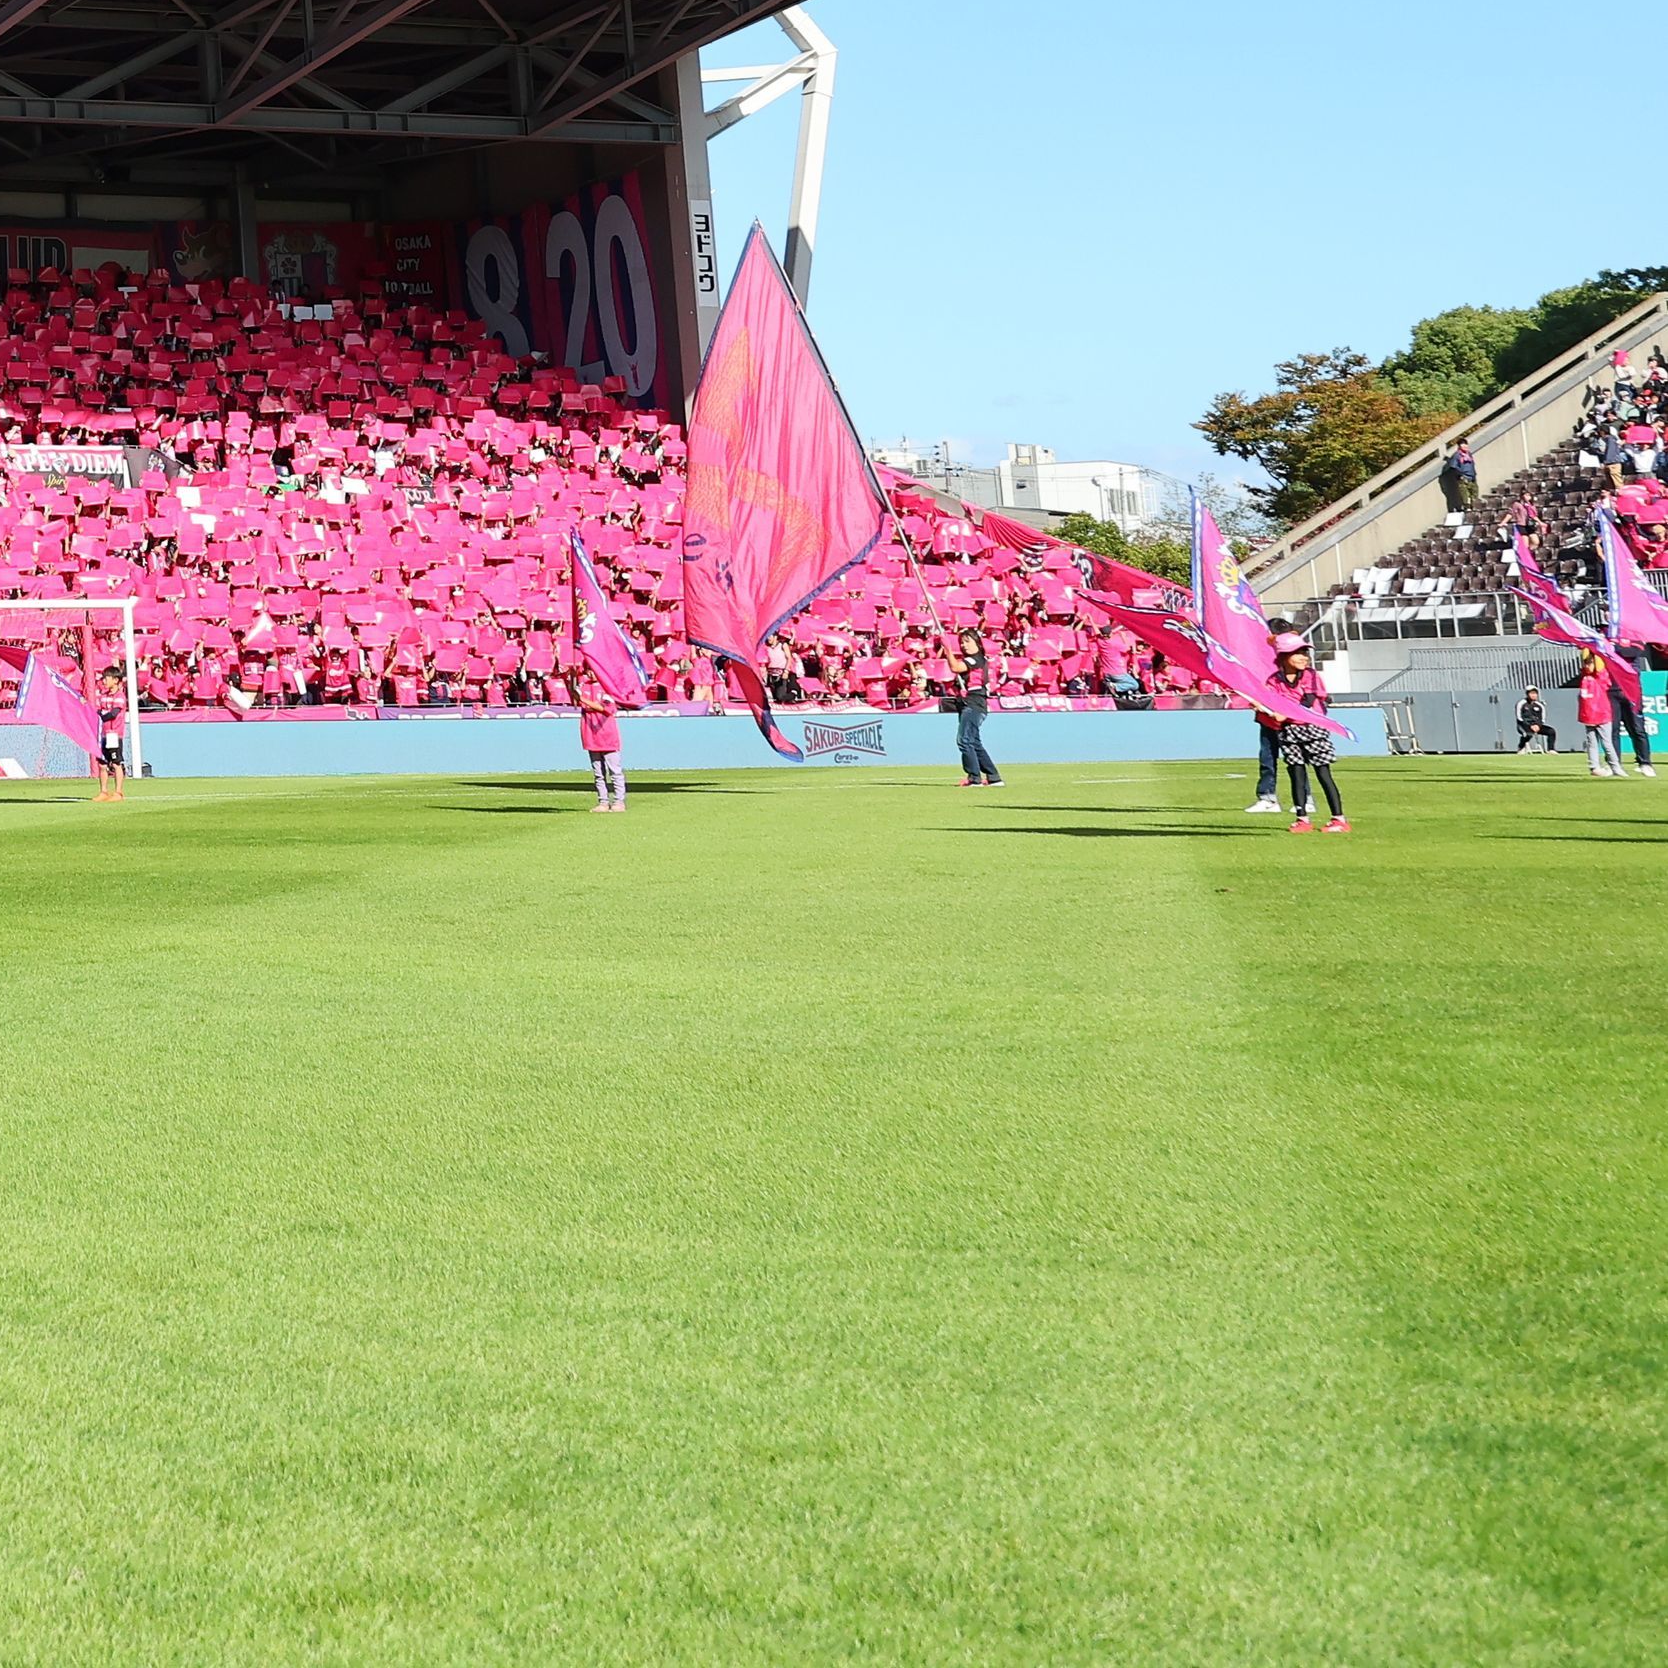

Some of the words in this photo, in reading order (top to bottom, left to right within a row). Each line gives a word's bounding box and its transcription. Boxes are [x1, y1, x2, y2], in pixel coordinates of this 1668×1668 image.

[394, 233, 432, 251] OSAKA
[694, 213, 715, 292] ヨドコウ
[545, 194, 658, 398] 20
[69, 452, 124, 475] DIEM
[804, 725, 844, 753] SAKURA
[845, 724, 884, 752] SPECTACLE
